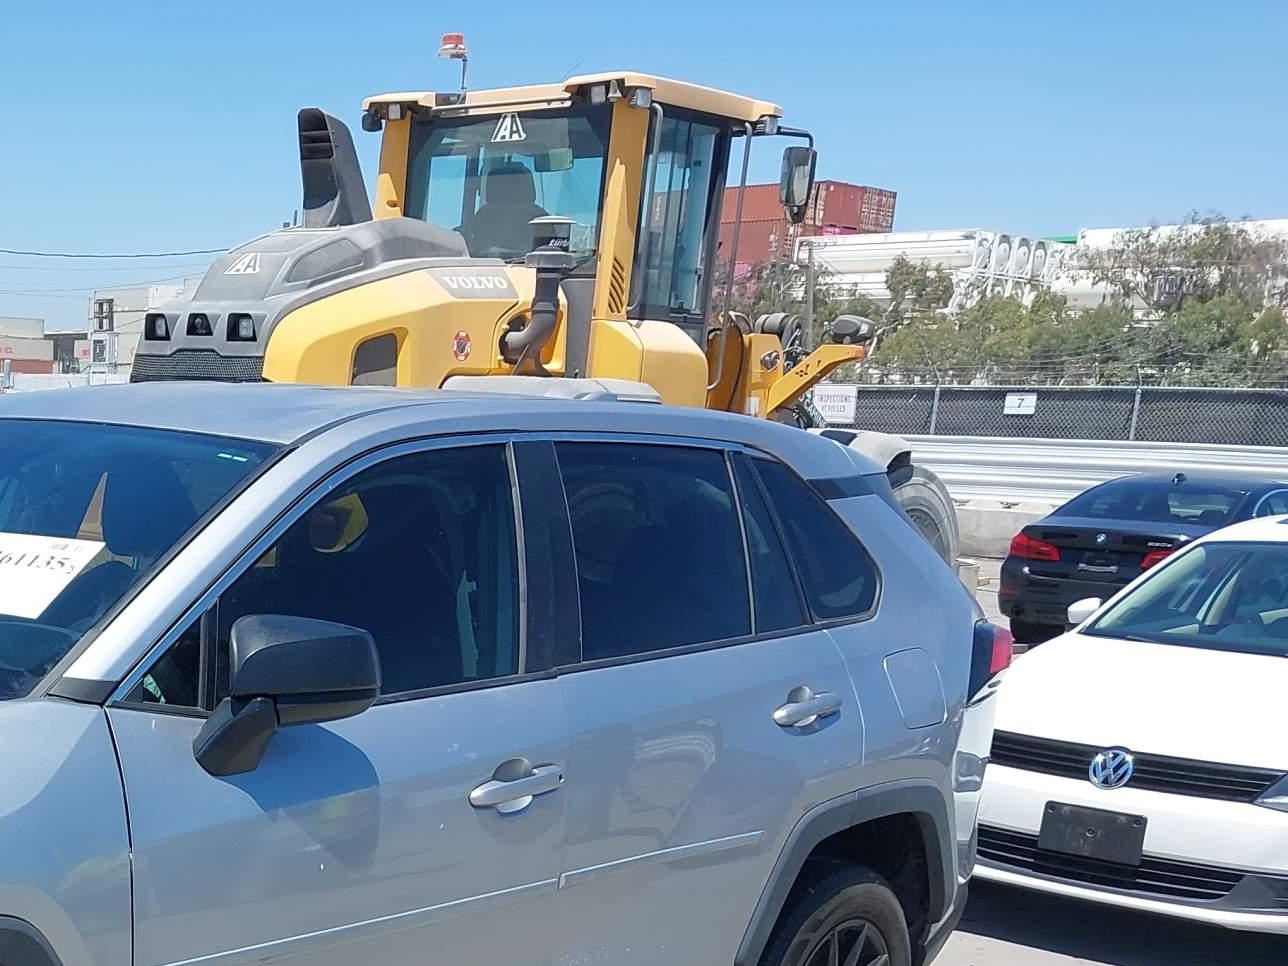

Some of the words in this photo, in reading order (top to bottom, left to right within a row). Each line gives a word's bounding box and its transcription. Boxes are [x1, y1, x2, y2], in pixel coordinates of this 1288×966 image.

[442, 276, 508, 289] VOLVO
[818, 394, 851, 403] INSPECTIONS
[1017, 398, 1024, 408] 7
